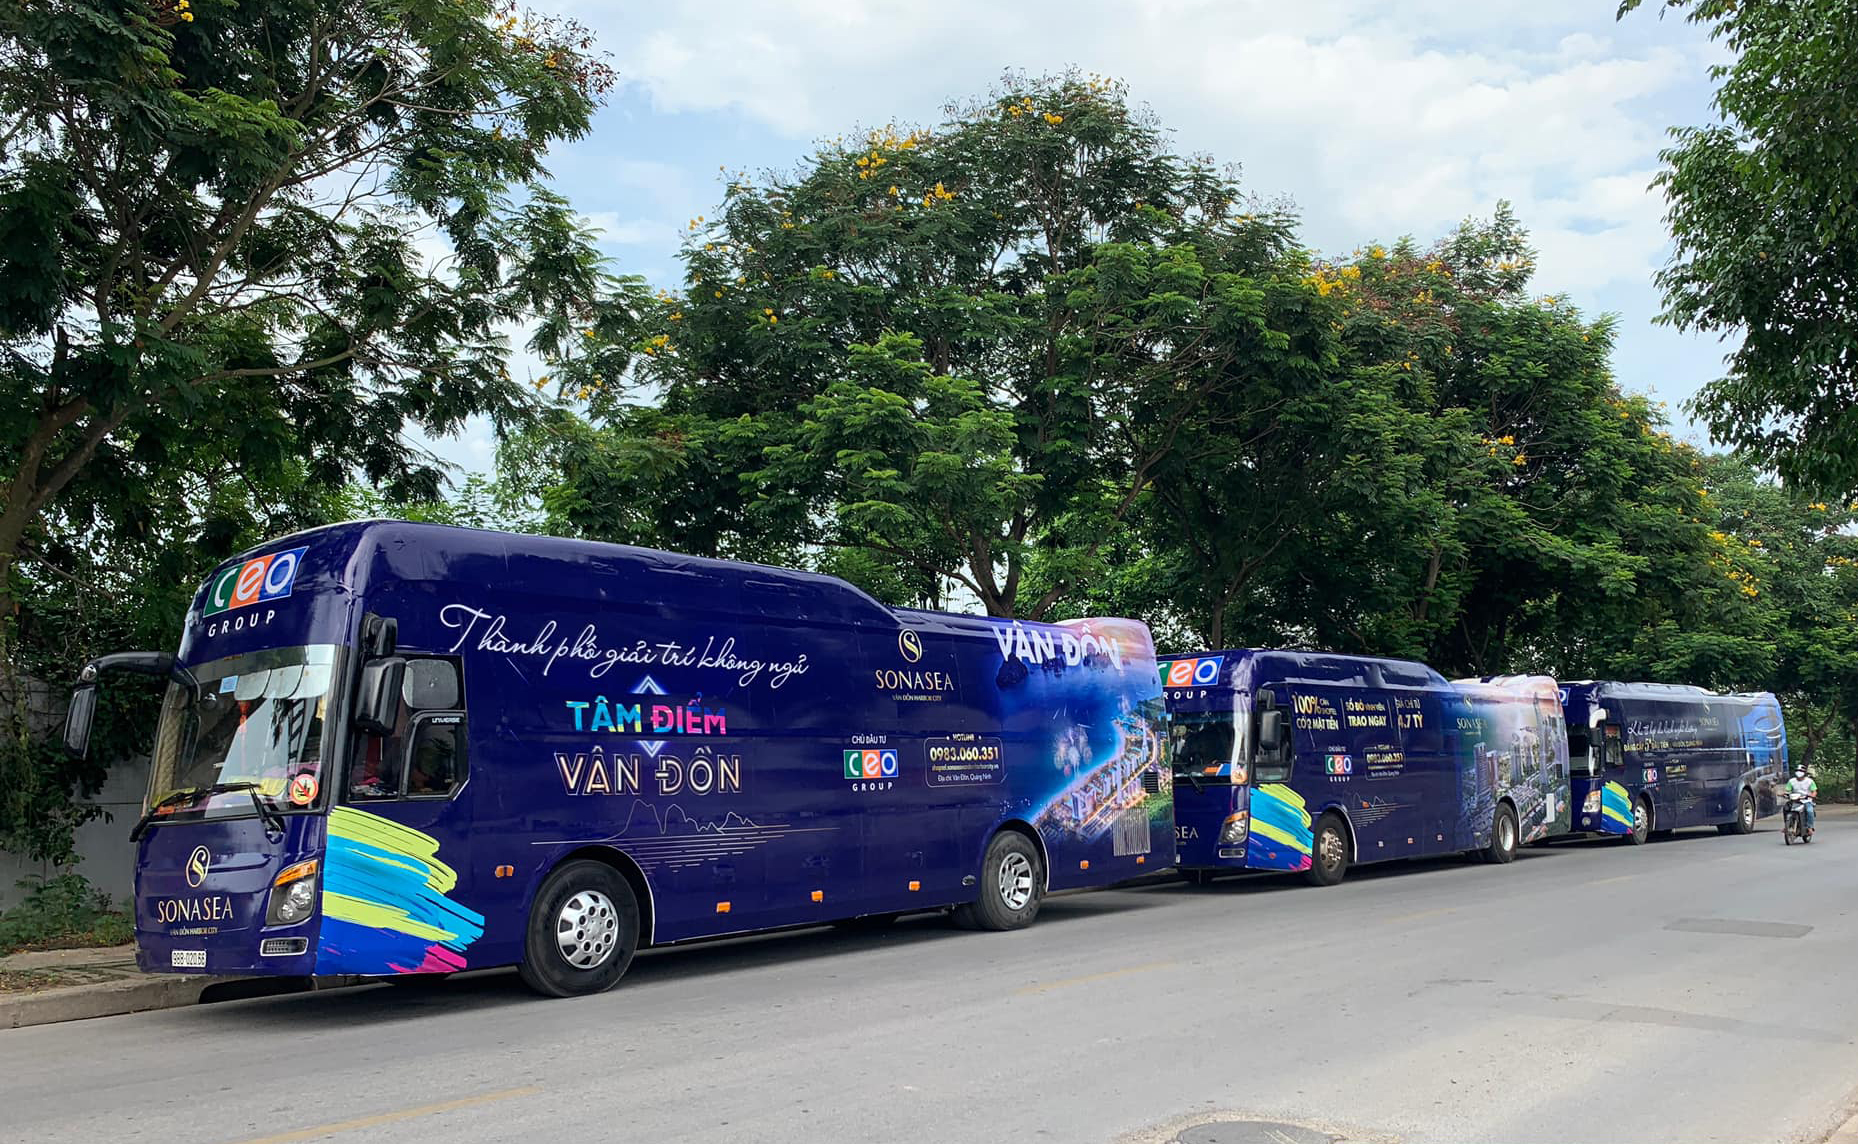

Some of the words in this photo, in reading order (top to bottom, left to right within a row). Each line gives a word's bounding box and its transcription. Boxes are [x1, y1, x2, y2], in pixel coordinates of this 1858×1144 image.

[208, 610, 275, 637] GROUP
[440, 604, 556, 655] Thành
[543, 624, 603, 676] phố
[590, 640, 657, 678] giải
[656, 641, 696, 666] trí
[697, 636, 766, 687] không
[768, 654, 809, 688] ngủ
[875, 669, 954, 691] SONASEA
[566, 695, 642, 732] TÂM
[651, 692, 727, 735] ĐIỂM
[929, 746, 999, 761] 0983.060.351
[554, 745, 641, 796] VÂN
[655, 746, 742, 796] ĐỒN
[852, 781, 893, 791] GROUP
[157, 896, 234, 924] SONASEA
